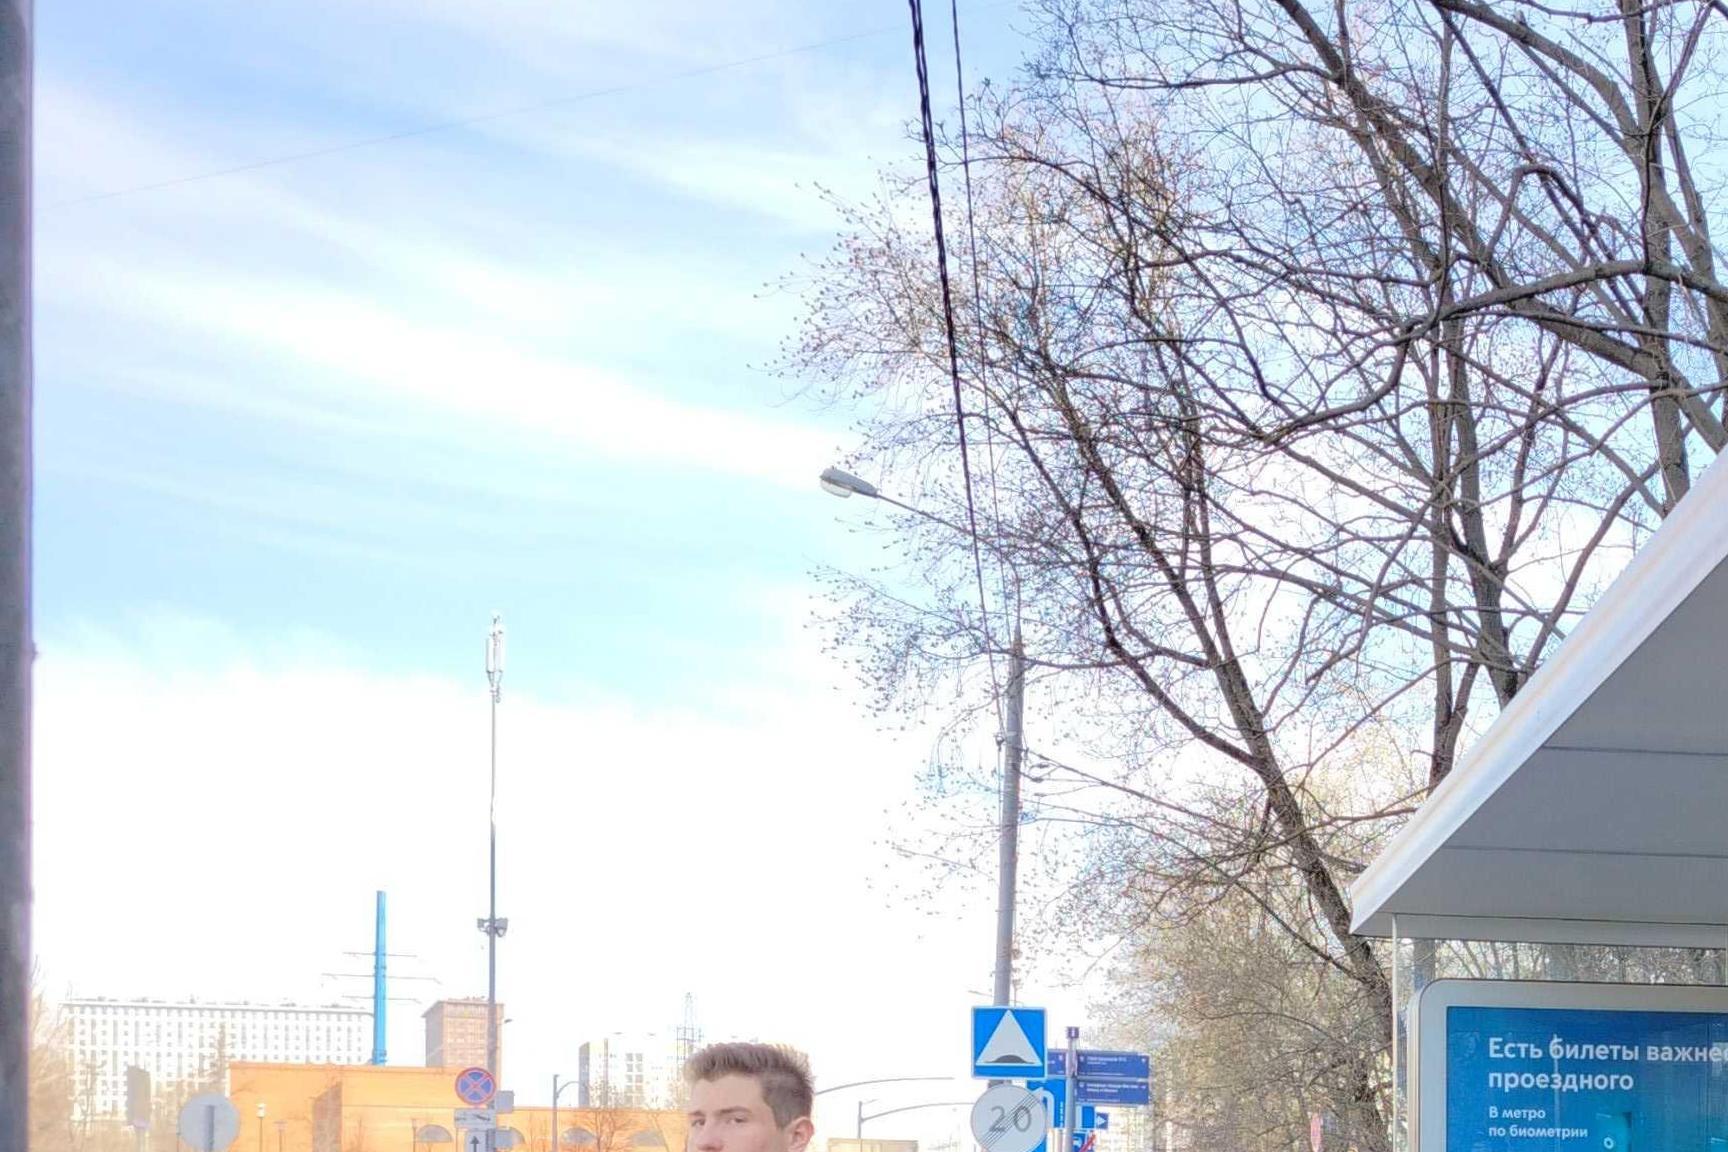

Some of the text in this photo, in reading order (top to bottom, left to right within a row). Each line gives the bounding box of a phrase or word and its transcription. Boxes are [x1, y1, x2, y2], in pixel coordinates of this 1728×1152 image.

[1489, 1037, 1543, 1060] Есть
[1549, 1036, 1639, 1061] билеты
[1489, 1072, 1634, 1093] проездного
[990, 1105, 1032, 1133] 20
[1489, 1106, 1547, 1121] В метро
[1488, 1125, 1589, 1140] по биометрии
